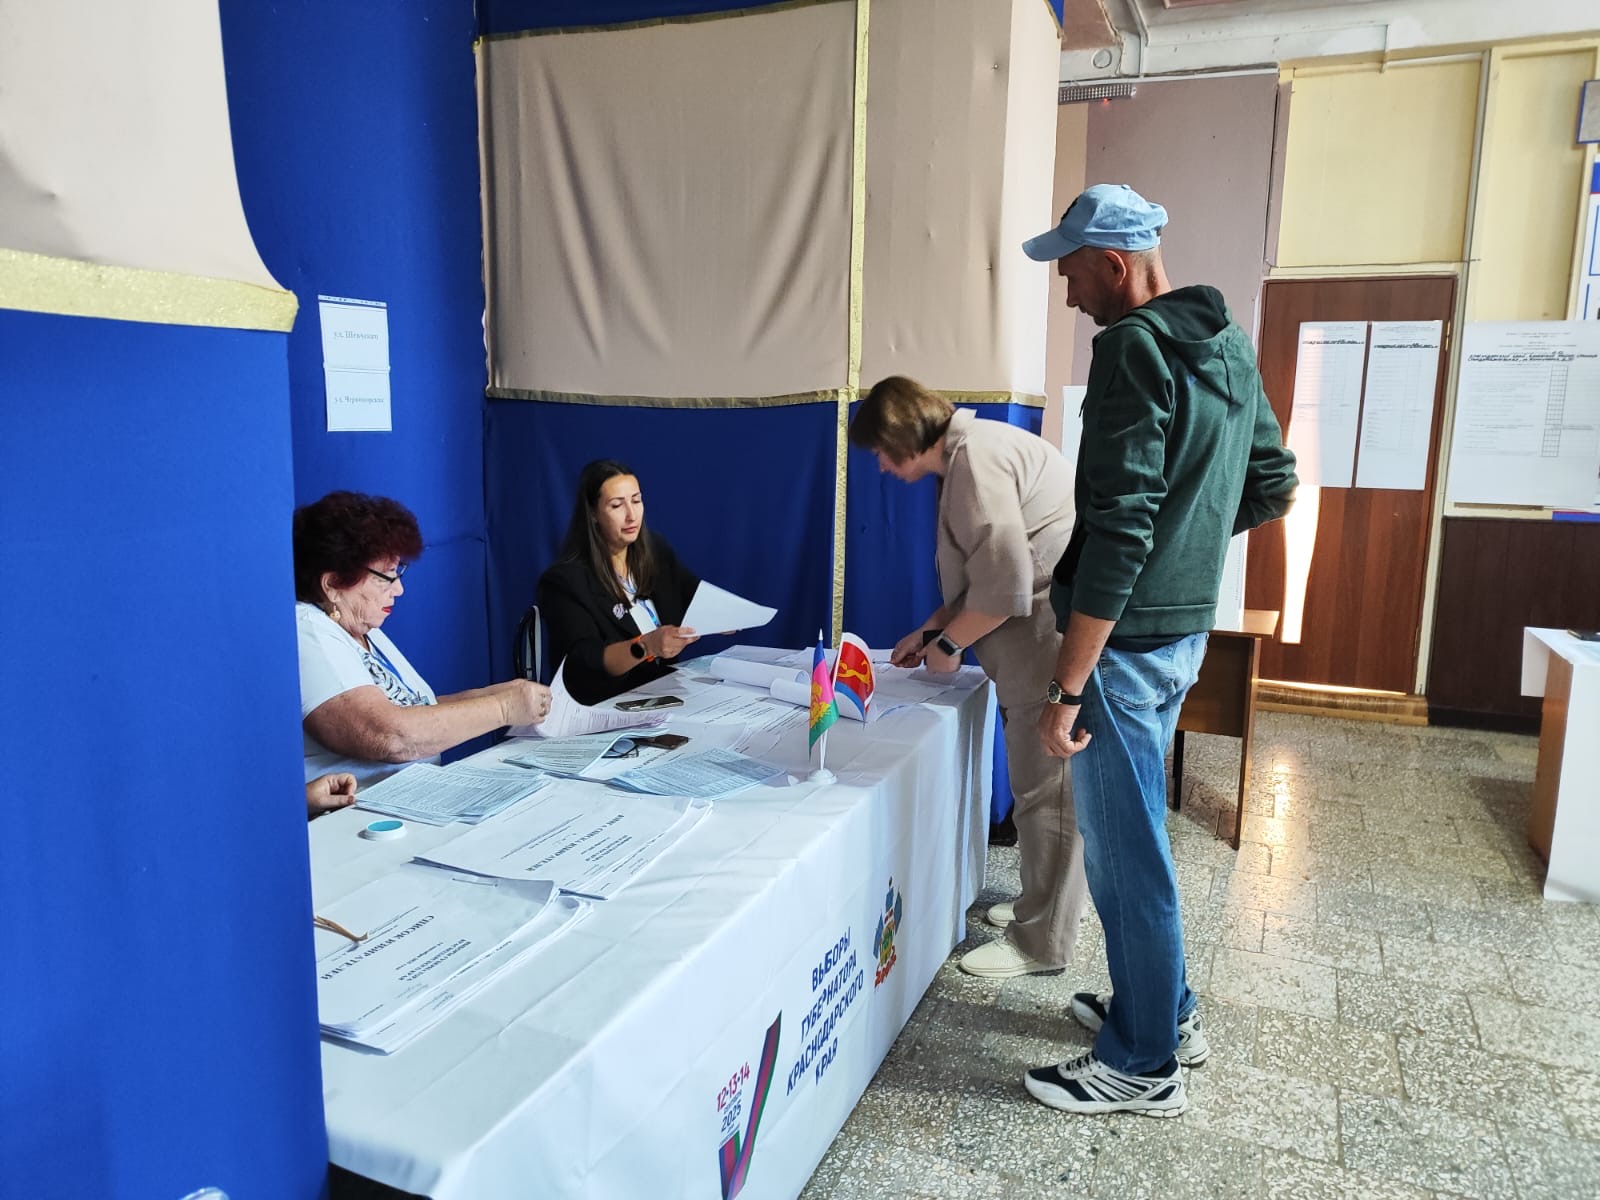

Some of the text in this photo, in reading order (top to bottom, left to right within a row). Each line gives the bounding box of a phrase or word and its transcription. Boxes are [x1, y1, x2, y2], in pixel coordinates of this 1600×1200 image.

[394, 915, 435, 939] СПИСОК
[812, 925, 851, 993] ВЫБОРЫ
[801, 949, 857, 1044] ГУБЕРНАТОРА
[787, 968, 864, 1097] КРАСНОДАРСКОГО
[815, 1036, 838, 1087] КРАЯ
[721, 1098, 742, 1133] 2025
